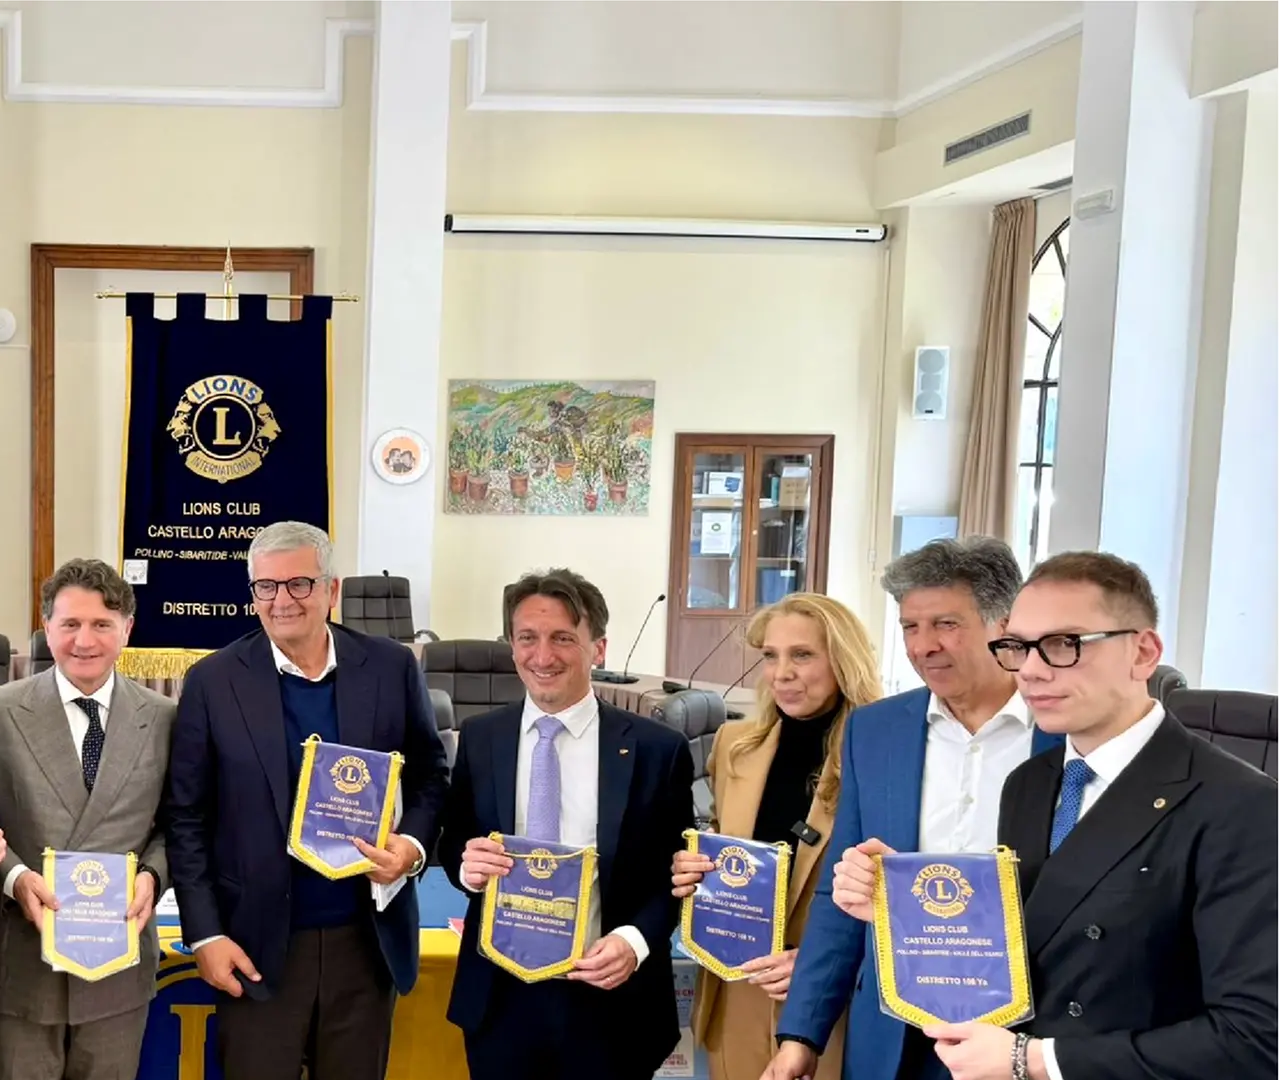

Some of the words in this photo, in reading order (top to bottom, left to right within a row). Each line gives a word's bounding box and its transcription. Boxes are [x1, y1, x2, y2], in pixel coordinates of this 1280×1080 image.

[192, 377, 258, 401] LIONS
[212, 407, 241, 445] L
[192, 455, 257, 476] INTERNATIONAL
[183, 502, 221, 515] LIONS
[226, 502, 261, 515] CLUB
[148, 525, 214, 539] CASTELLO
[134, 548, 174, 558] POLLINO
[163, 601, 237, 616] DISTRETTO
[243, 602, 260, 616] 10
[923, 865, 958, 878] LIONS
[923, 925, 946, 933] LIONS
[947, 925, 968, 933] CLUB
[903, 937, 944, 945] CASTELLO
[944, 938, 993, 946] ARAGONESE
[916, 976, 961, 985] DISTRETTO
